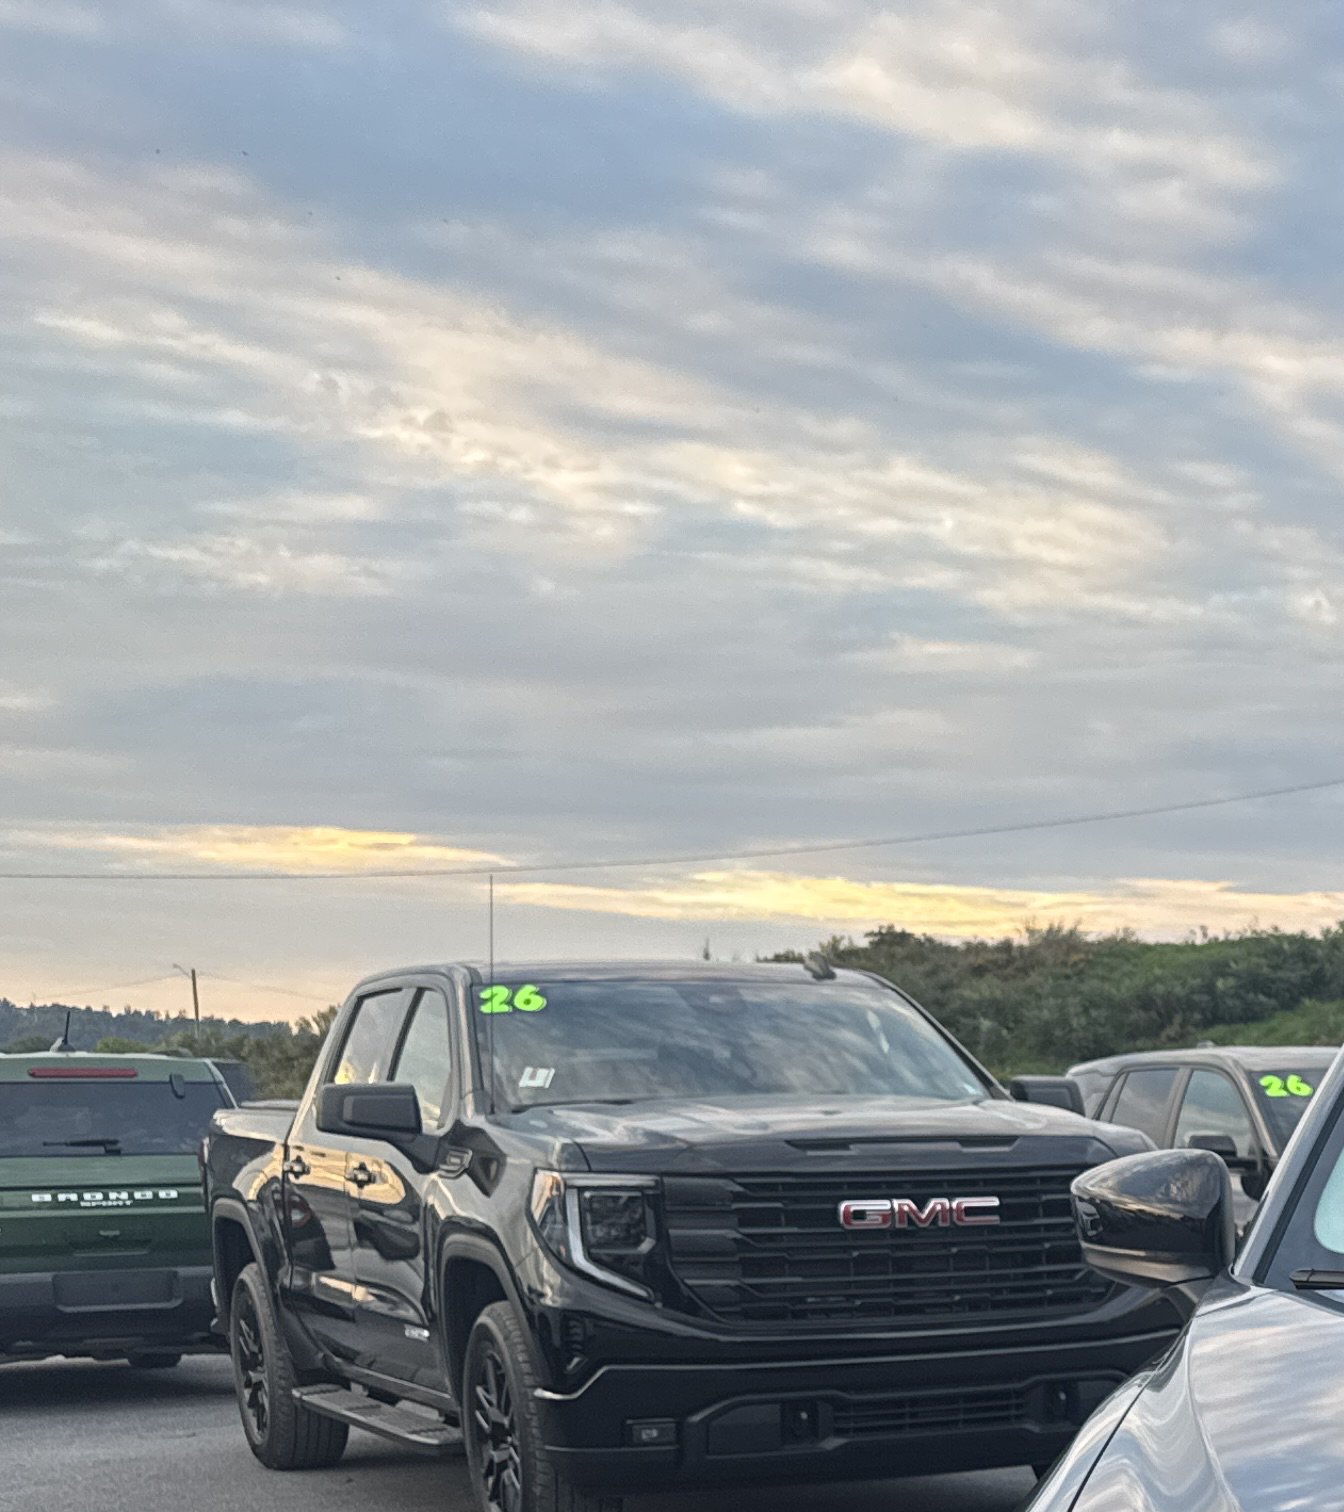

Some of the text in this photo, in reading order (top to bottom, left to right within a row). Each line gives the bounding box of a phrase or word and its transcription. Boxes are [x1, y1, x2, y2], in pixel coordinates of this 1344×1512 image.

[479, 984, 547, 1014] 26
[1259, 1074, 1314, 1097] 26
[31, 1190, 178, 1202] BRONCO
[838, 1196, 1000, 1229] GMC
